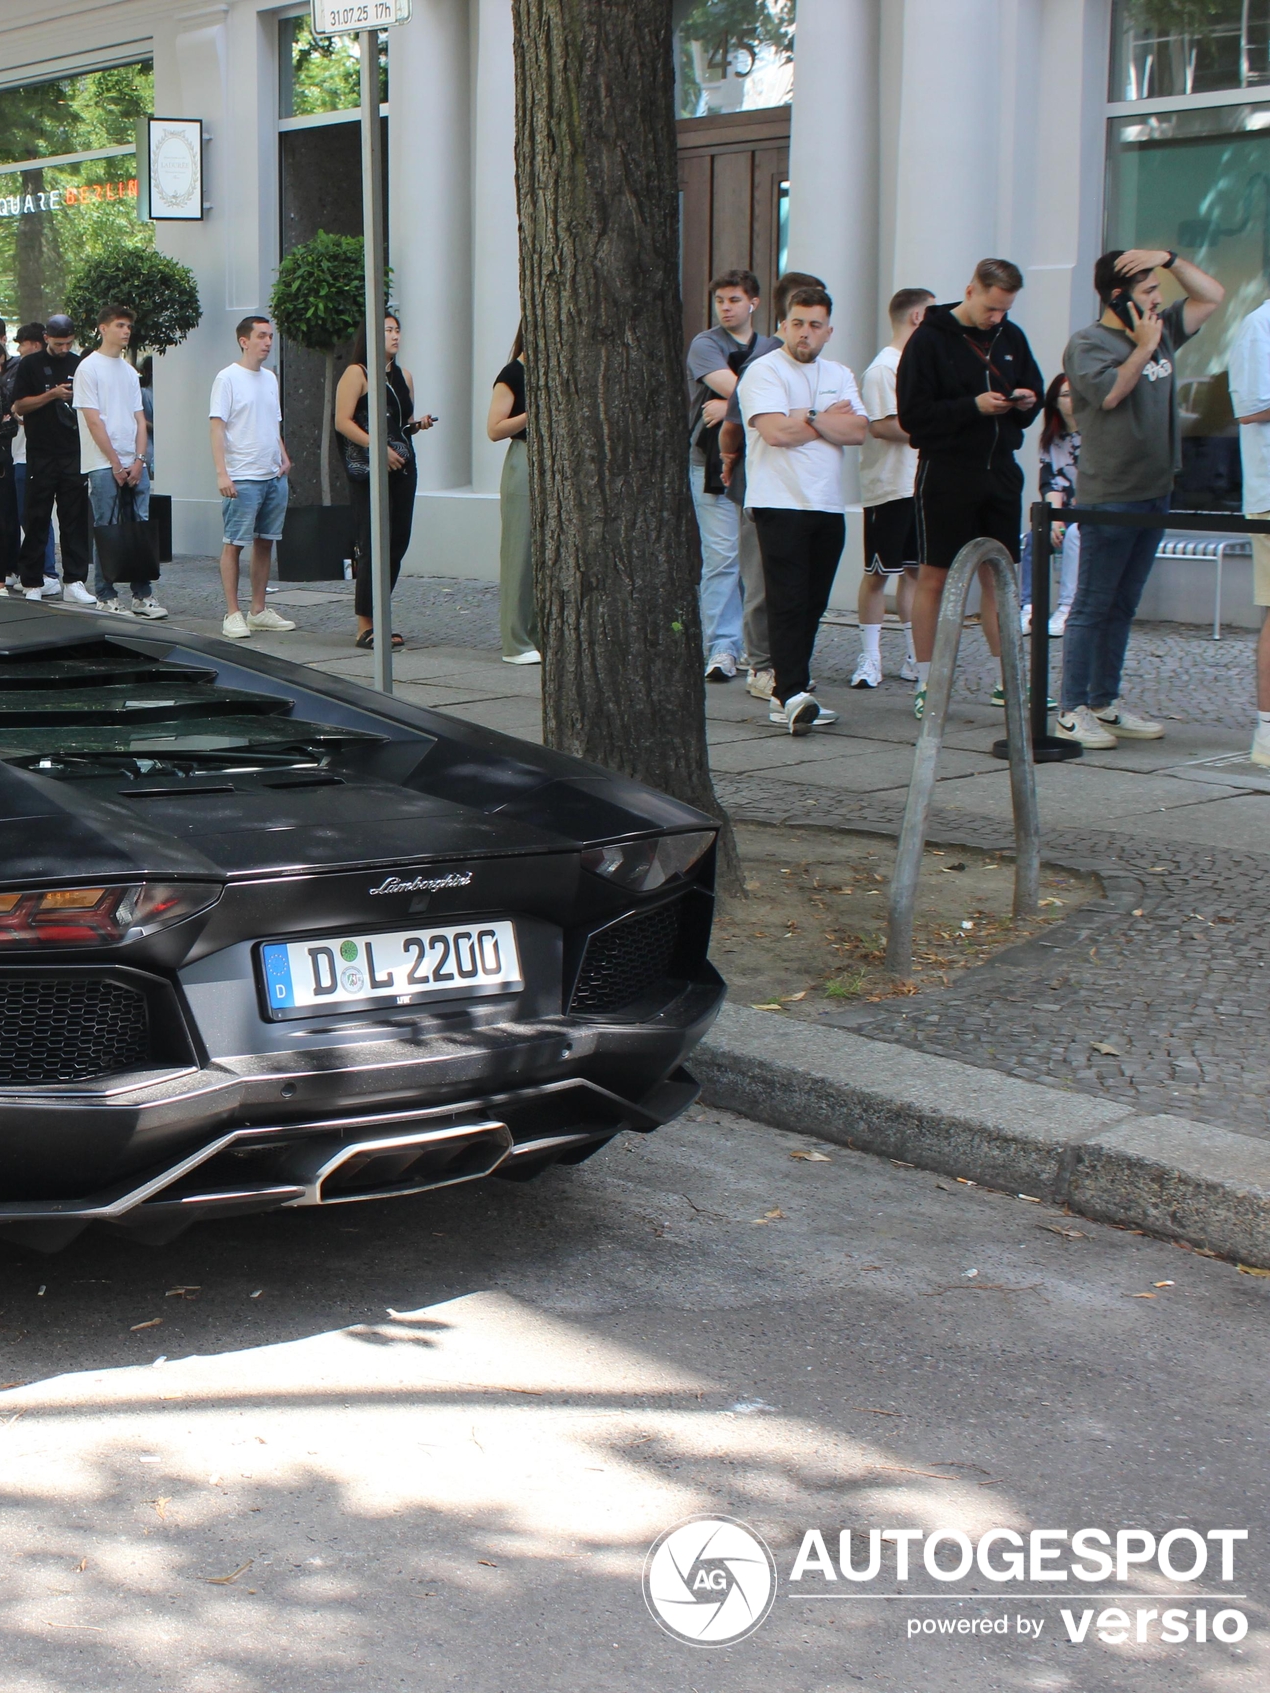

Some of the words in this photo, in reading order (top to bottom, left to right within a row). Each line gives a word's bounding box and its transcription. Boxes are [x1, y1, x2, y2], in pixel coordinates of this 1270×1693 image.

[330, 6, 368, 26] 31.07.25
[375, 3, 391, 20] 17h
[707, 27, 757, 79] 45
[65, 179, 139, 205] BERLIN
[369, 871, 473, 896] Lamborghini
[307, 946, 338, 996] D
[364, 941, 394, 990] L
[403, 929, 502, 986] 2200
[276, 984, 286, 998] D
